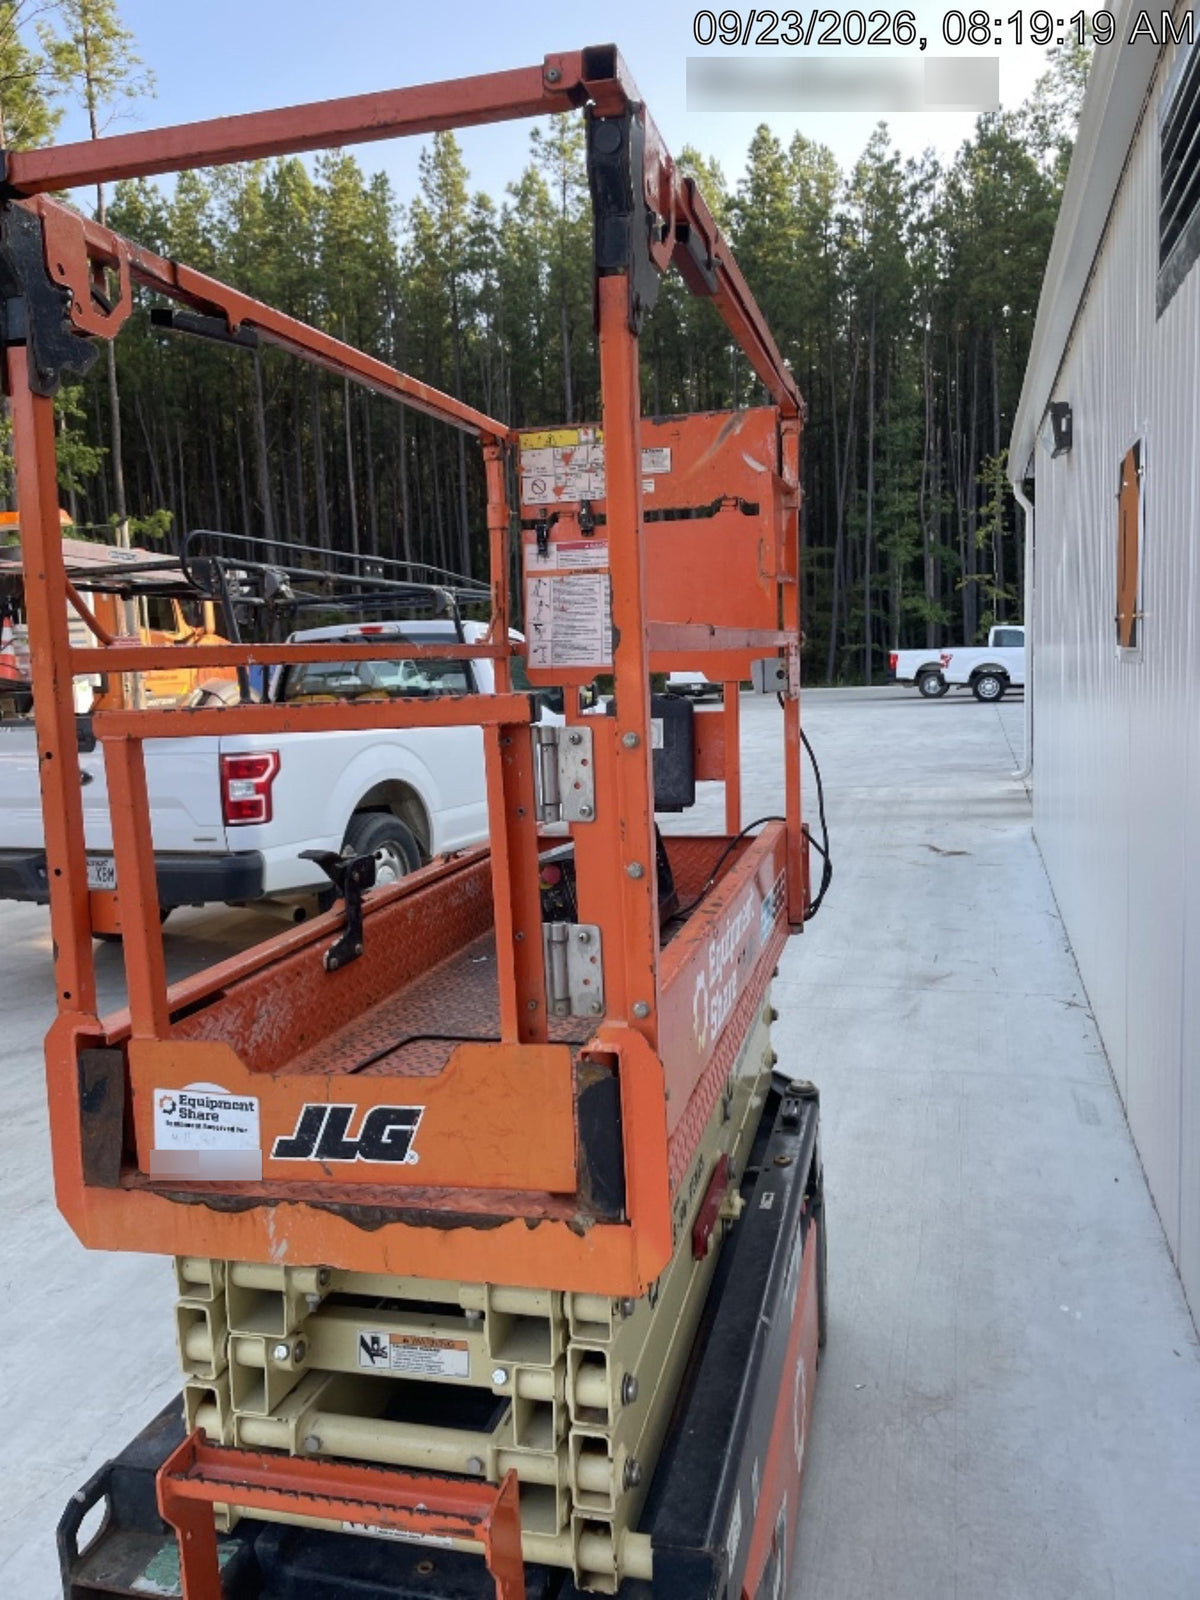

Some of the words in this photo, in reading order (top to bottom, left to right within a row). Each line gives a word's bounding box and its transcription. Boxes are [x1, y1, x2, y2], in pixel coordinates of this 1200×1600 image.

[179, 1094, 255, 1112] Equipment
[179, 1107, 220, 1122] Share
[270, 1104, 425, 1163] JLG
